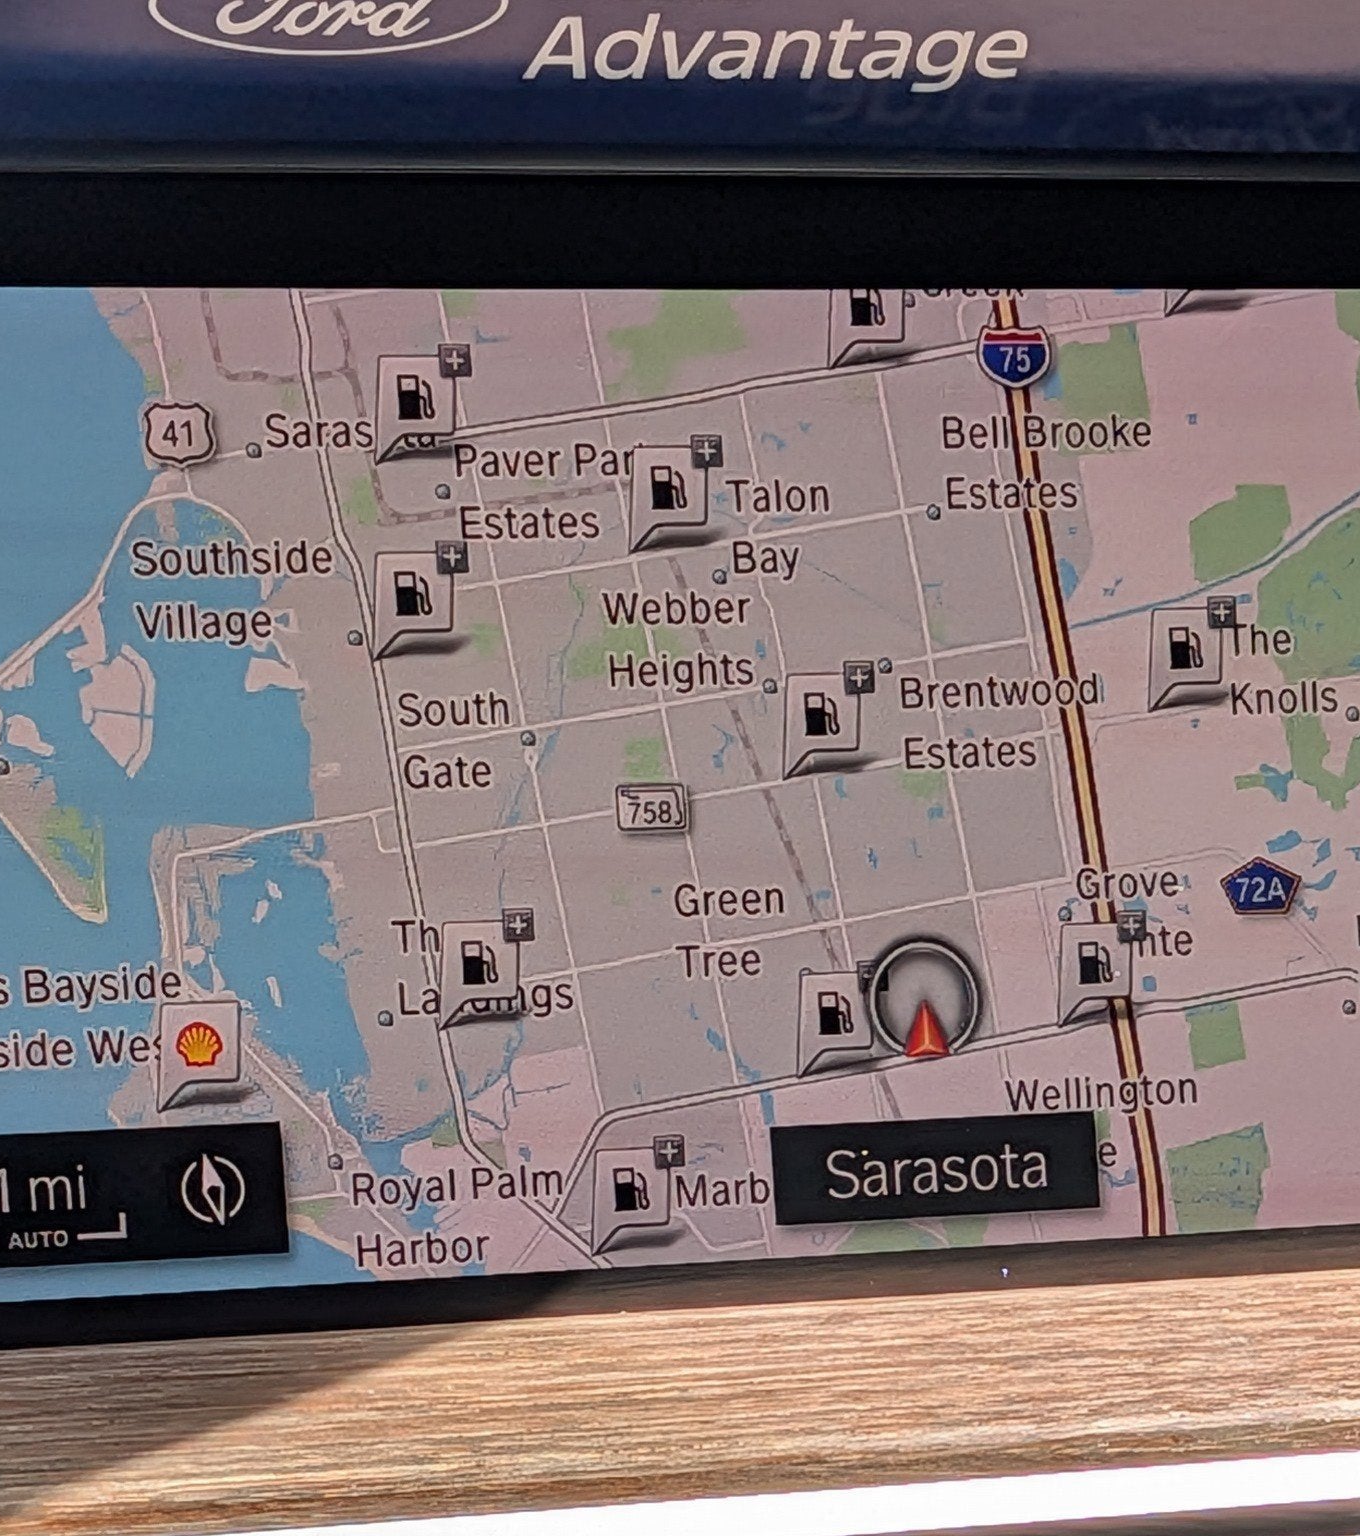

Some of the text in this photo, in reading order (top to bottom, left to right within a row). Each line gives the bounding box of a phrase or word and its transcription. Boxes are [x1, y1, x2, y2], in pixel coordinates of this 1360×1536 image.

[523, 14, 1029, 93] Advantage
[999, 347, 1031, 372] 75
[162, 421, 193, 446] 41
[942, 416, 1151, 449] Bell Brooke
[456, 442, 643, 478] Paver Par
[727, 481, 830, 512] Talon
[947, 478, 1078, 510] Estates
[460, 508, 599, 540] Estates
[133, 542, 332, 576] Southside
[733, 543, 799, 580] Bay
[138, 606, 272, 644] Village
[603, 593, 750, 625] Webber
[1231, 624, 1291, 655] The
[609, 655, 754, 691] Heights
[901, 673, 1098, 709] Brentwood
[1231, 685, 1339, 716] Knolls
[398, 694, 509, 727] South
[905, 737, 1036, 770] Estates
[404, 757, 492, 789] Gate
[628, 802, 671, 824] 758
[1077, 867, 1179, 900] Grove
[1235, 876, 1287, 902] 72A
[675, 885, 784, 917] Green
[677, 946, 760, 978] Tree
[25, 965, 181, 1008] Bayside
[1007, 1076, 1197, 1112] Wellington
[30, 1166, 85, 1210] mi
[353, 1166, 562, 1207] Royal Palm
[826, 1144, 1049, 1199] Sarasota
[9, 1230, 68, 1249] AUTO
[357, 1233, 489, 1267] Harbor
